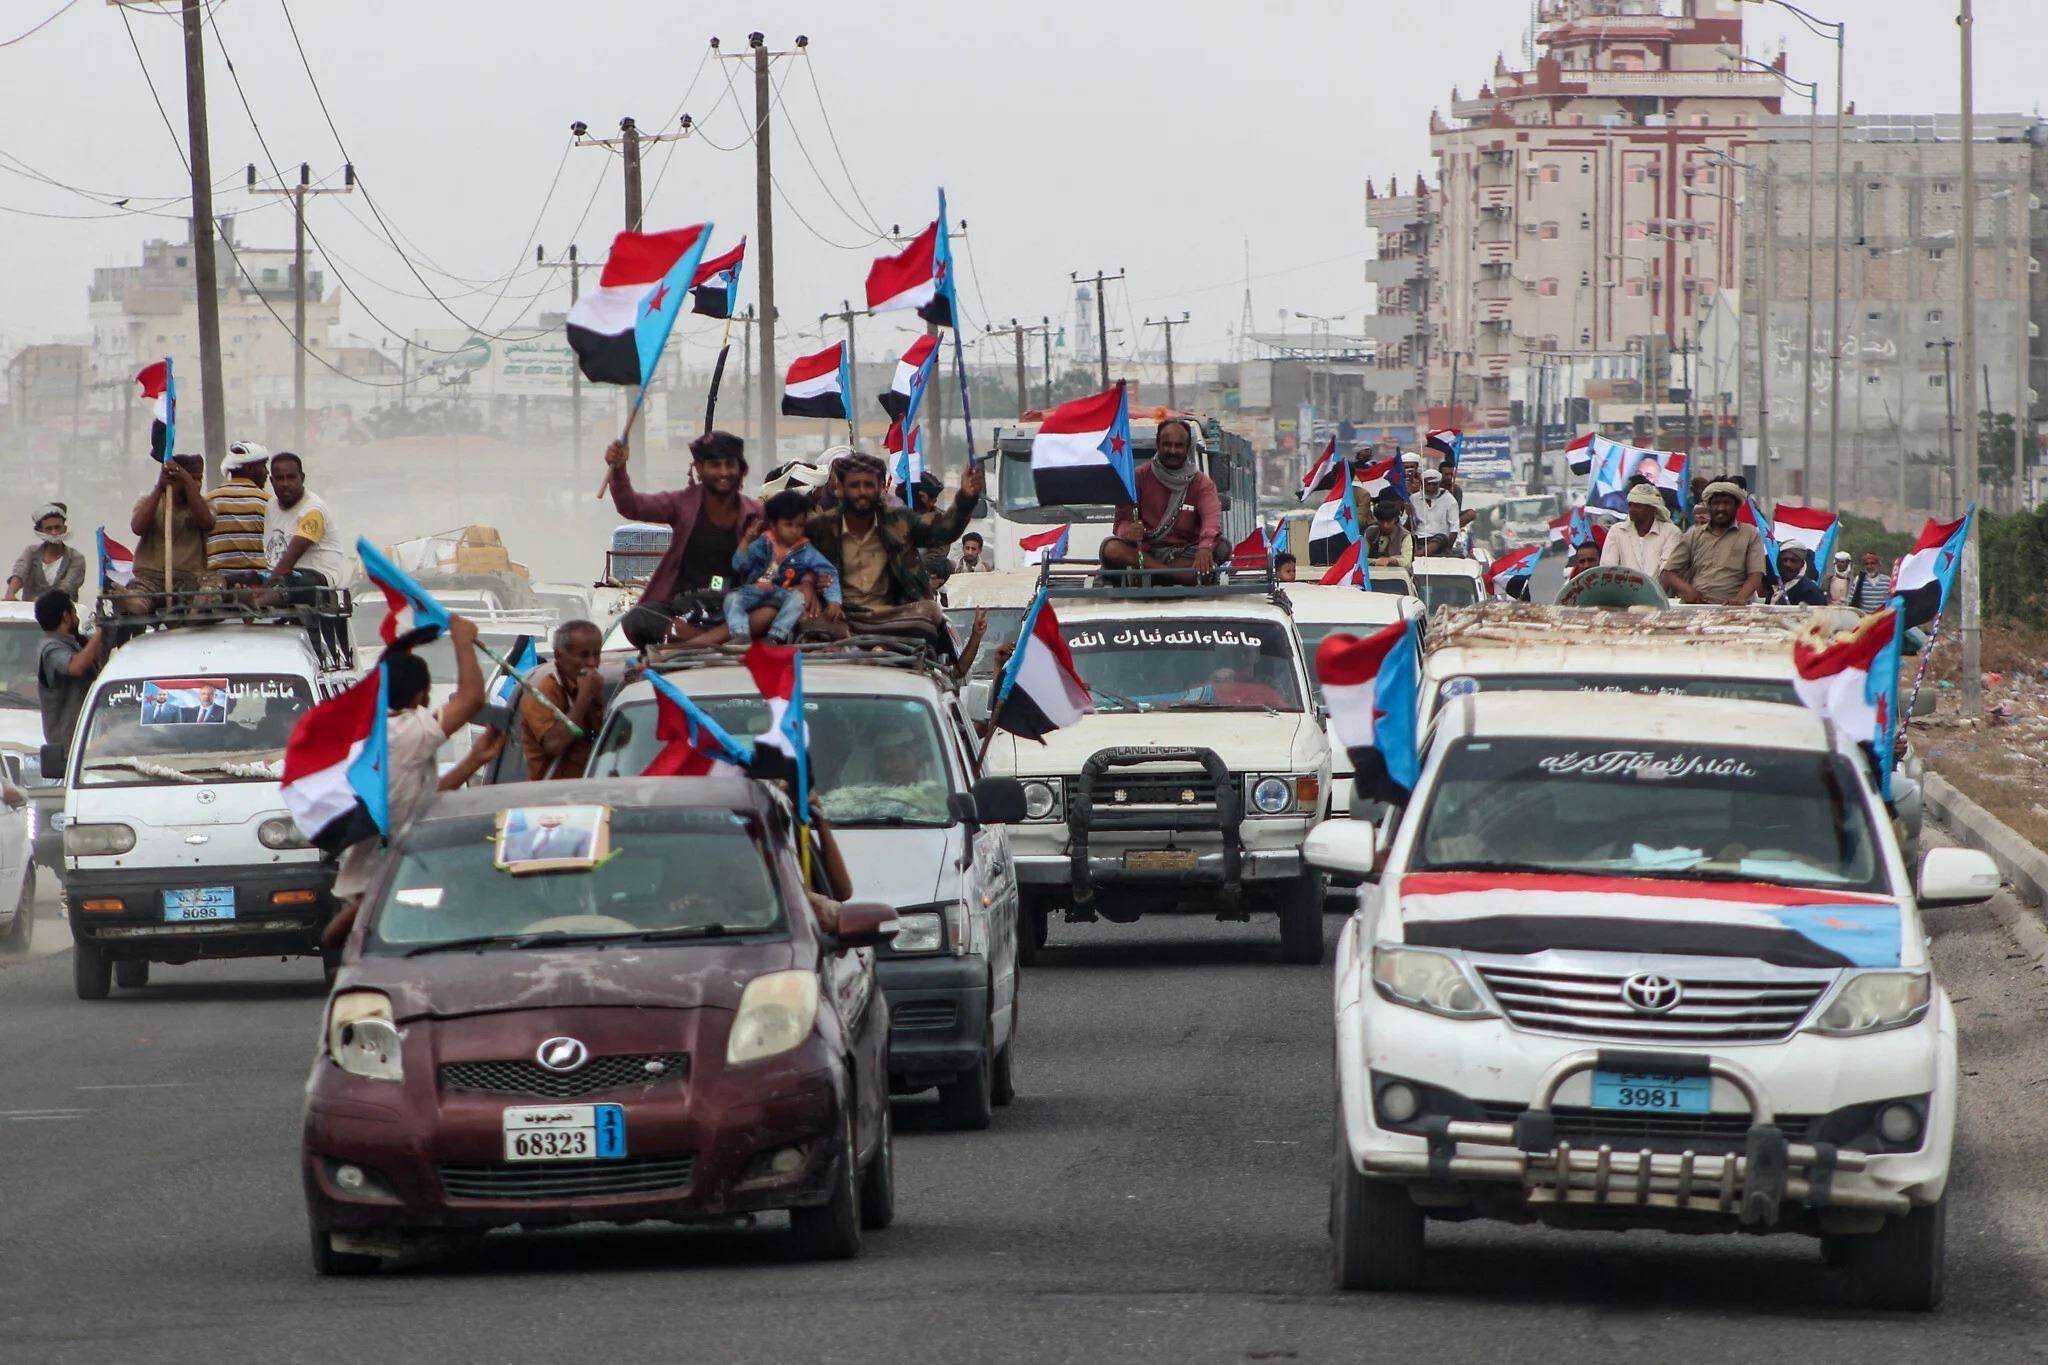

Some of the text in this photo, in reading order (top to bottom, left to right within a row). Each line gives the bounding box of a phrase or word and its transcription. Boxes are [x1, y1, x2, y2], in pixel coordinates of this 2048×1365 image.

[1068, 632, 1106, 648] الله
[1113, 628, 1162, 647] تبارك
[1165, 630, 1202, 645] الله
[108, 684, 136, 706] النبي
[182, 907, 217, 919] 8098
[1618, 1087, 1681, 1108] 3981
[515, 1131, 587, 1156] 68323
